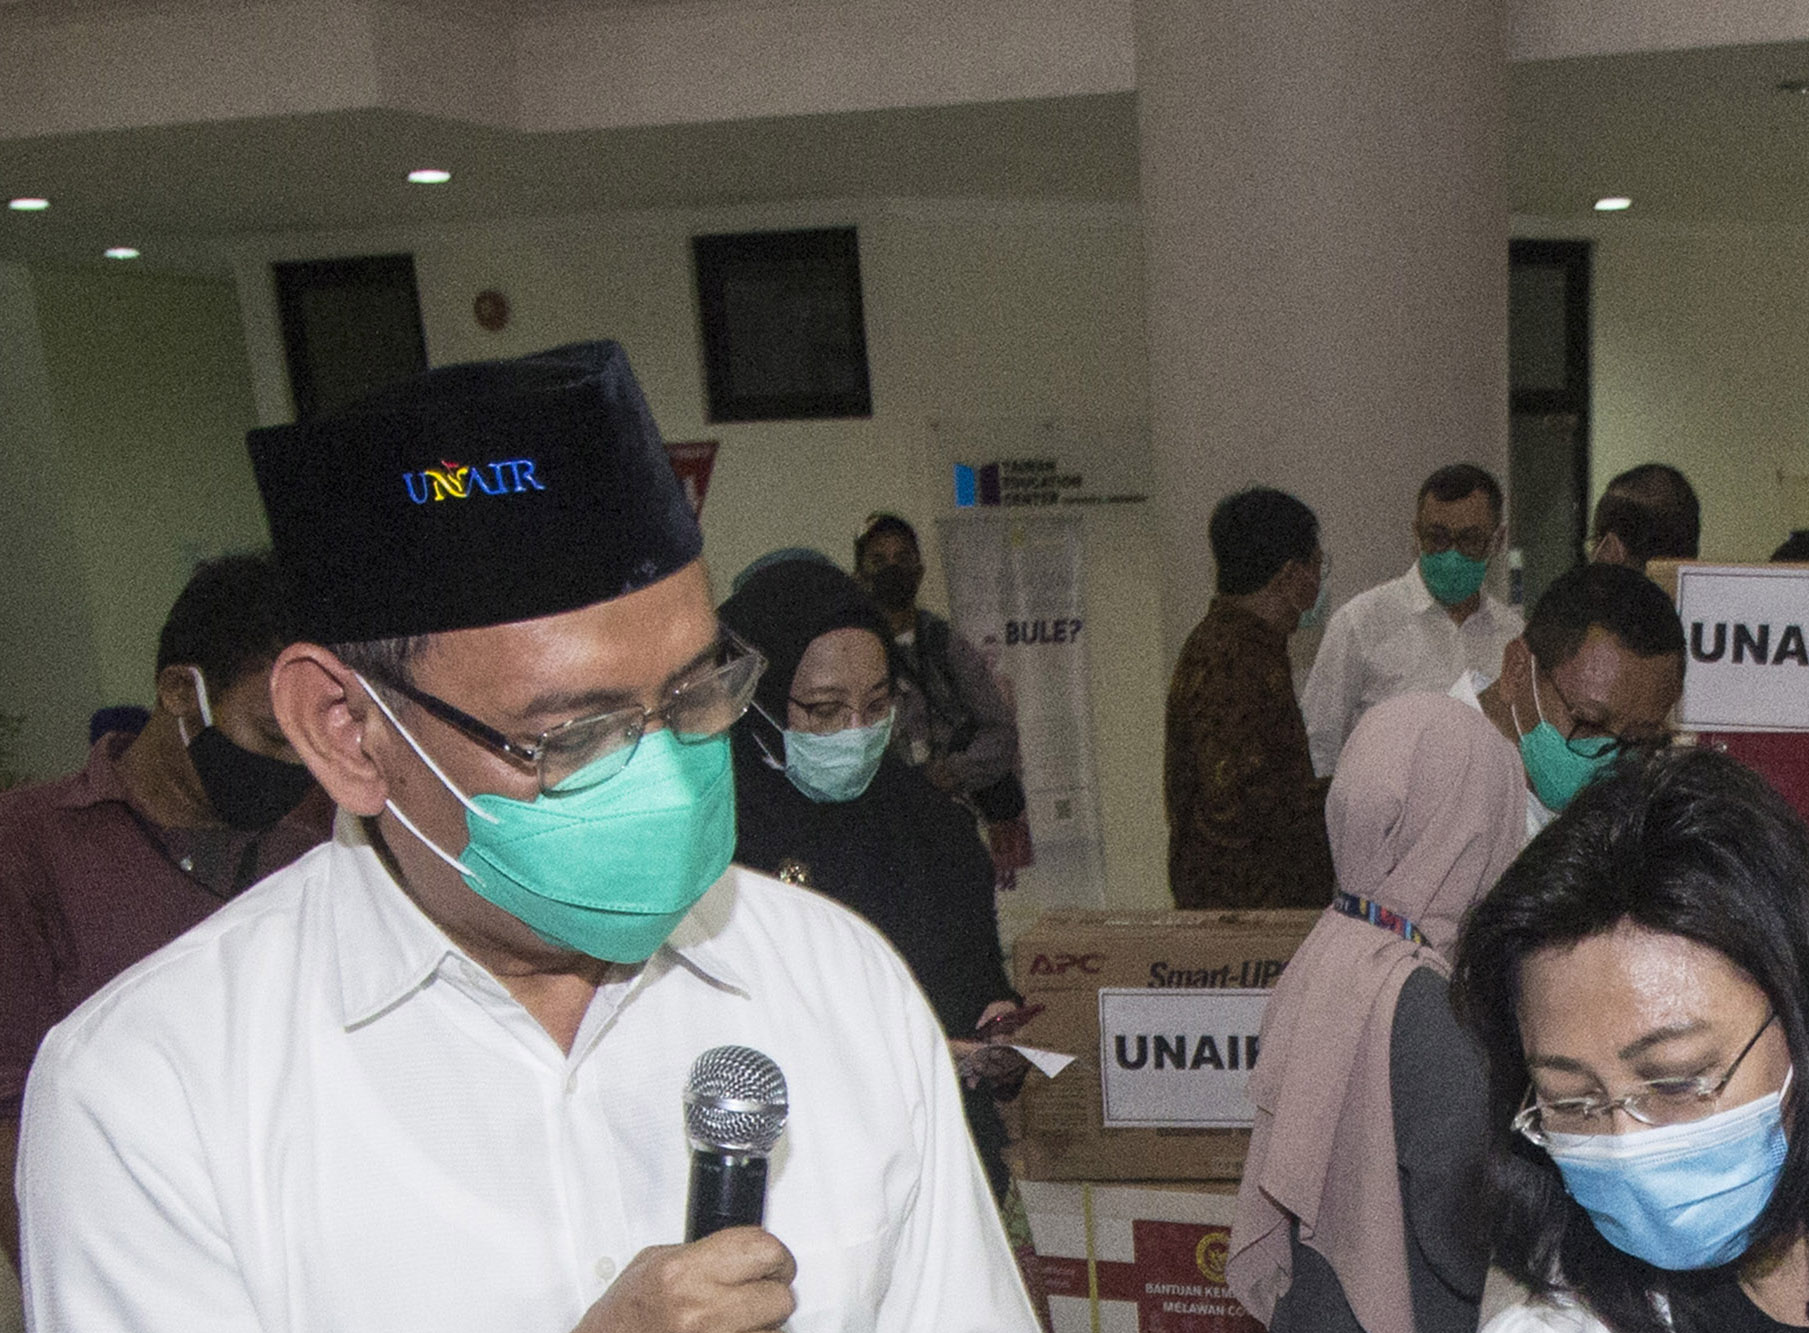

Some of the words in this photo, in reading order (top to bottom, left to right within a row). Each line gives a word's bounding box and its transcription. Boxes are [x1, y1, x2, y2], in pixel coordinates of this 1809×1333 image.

[403, 457, 545, 505] UNAIR
[1005, 618, 1083, 646] BULE?
[1030, 953, 1102, 976] APC
[1148, 960, 1291, 989] Smart-UP
[1145, 1283, 1202, 1297] BANTUAN
[1163, 1301, 1225, 1315] MELAWAN
